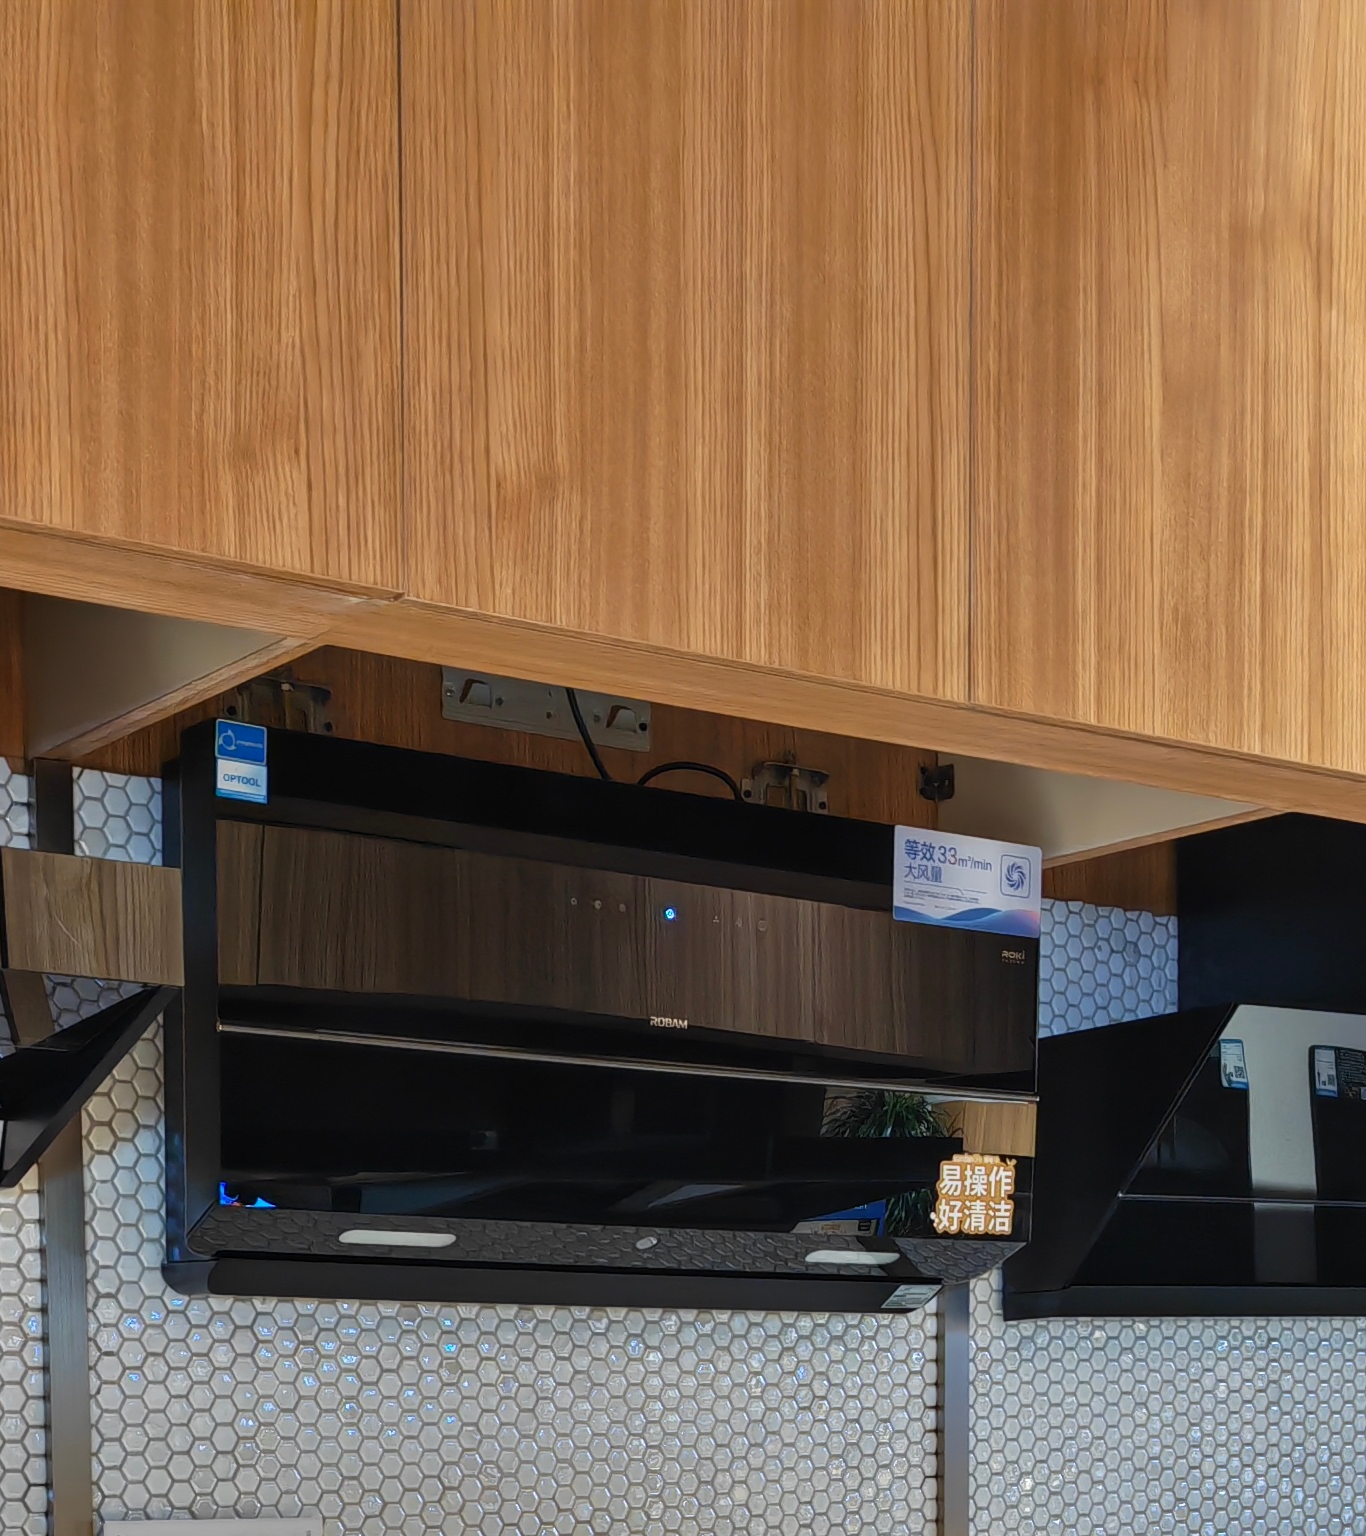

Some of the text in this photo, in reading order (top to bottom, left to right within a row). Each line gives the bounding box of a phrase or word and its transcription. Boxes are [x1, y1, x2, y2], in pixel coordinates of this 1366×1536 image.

[222, 773, 262, 788] OPTOOL
[649, 1016, 689, 1030] ROBAM
[939, 1164, 1013, 1198] 易操作
[938, 1198, 1012, 1232] 好清洁
